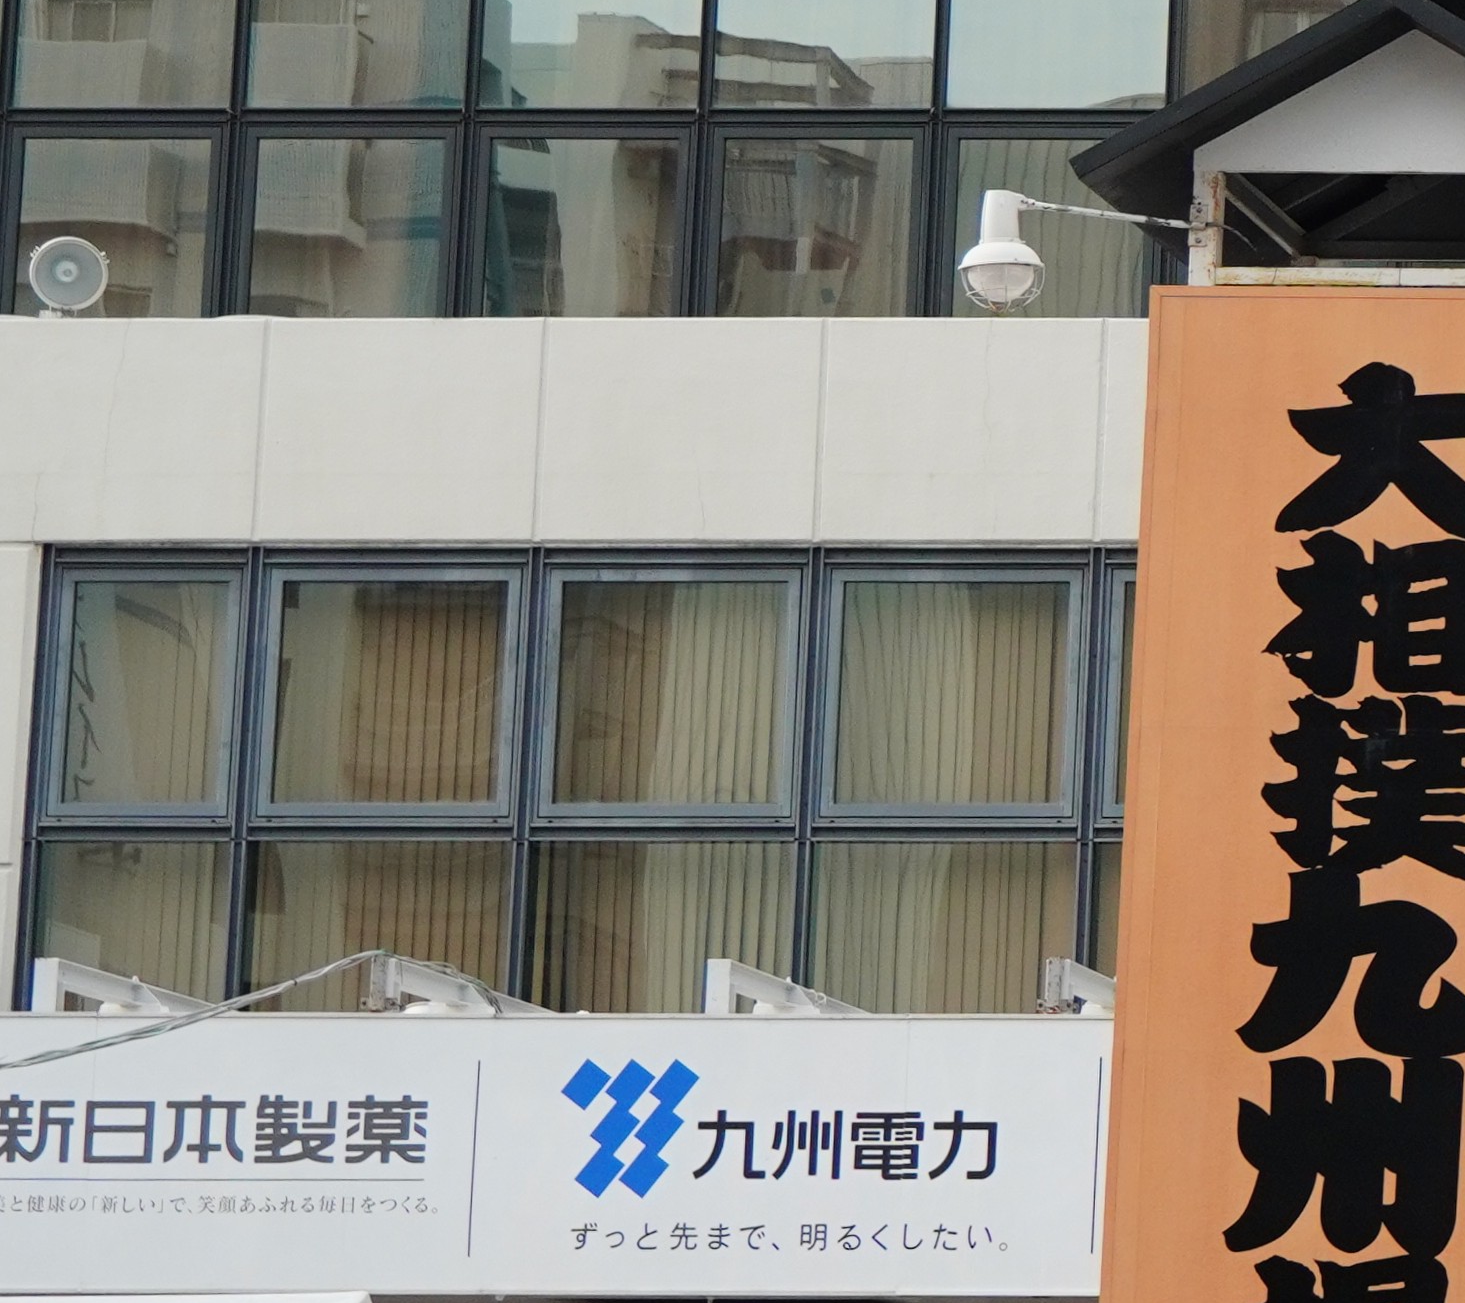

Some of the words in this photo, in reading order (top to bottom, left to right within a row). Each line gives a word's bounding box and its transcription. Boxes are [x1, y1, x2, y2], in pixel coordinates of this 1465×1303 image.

[0, 1095, 428, 1164] 新日本製薬
[692, 1109, 998, 1180] 九州電力
